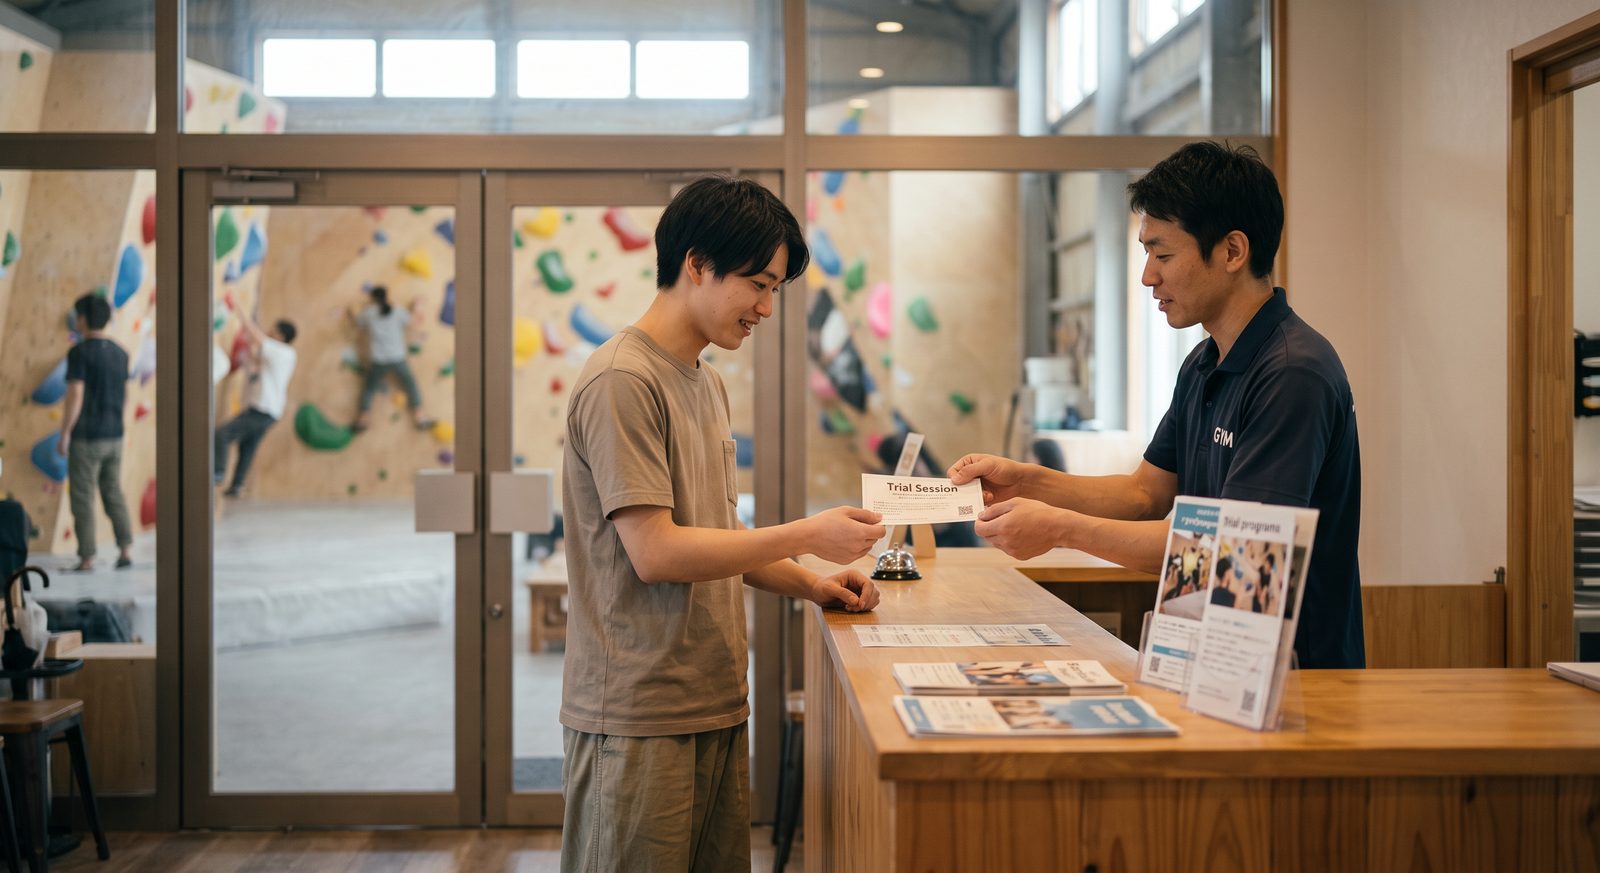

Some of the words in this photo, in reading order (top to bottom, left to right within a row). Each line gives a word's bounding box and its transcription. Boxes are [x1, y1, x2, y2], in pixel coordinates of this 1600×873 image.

[1213, 426, 1234, 448] GYM
[887, 482, 912, 492] Trial
[915, 484, 958, 493] Session
[1223, 516, 1240, 528] Trial
[1241, 519, 1281, 534] programs
